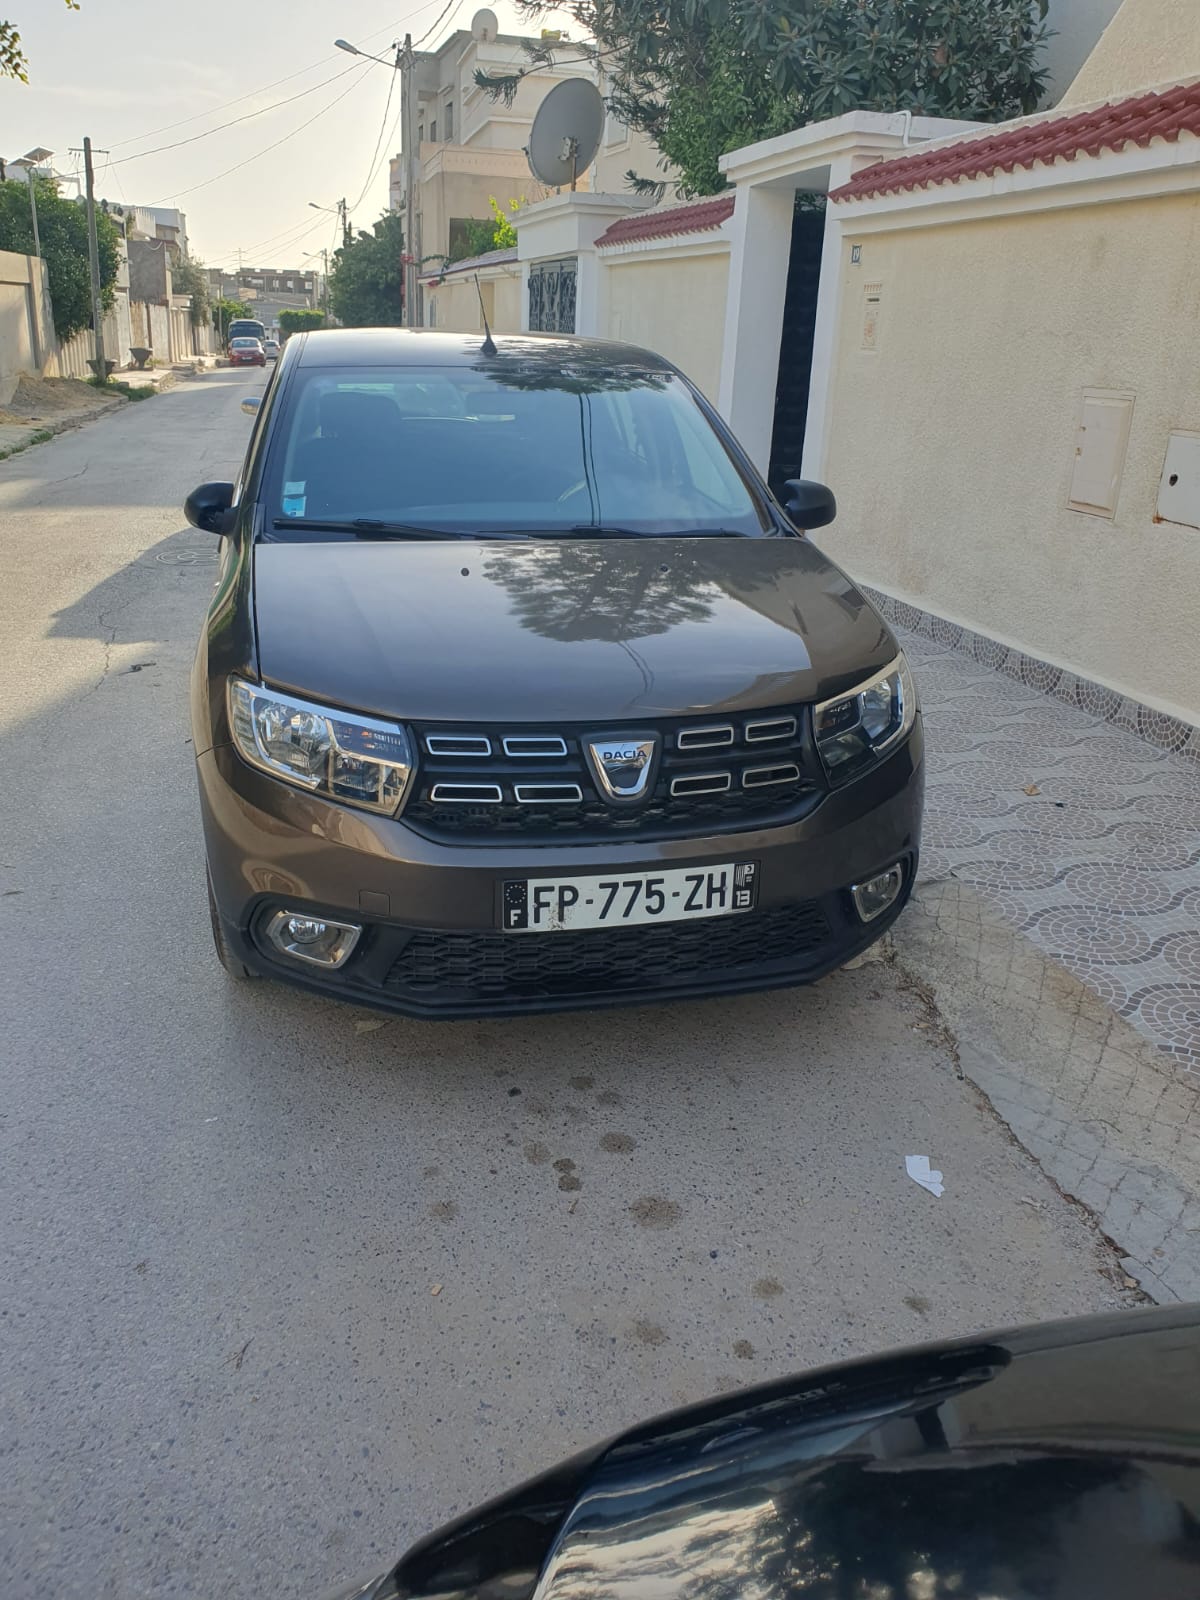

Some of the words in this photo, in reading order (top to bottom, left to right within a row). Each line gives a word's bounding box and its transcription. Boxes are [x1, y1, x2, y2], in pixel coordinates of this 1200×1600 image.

[603, 750, 647, 760] DACIA
[533, 872, 727, 923] FP-775-ZH
[736, 890, 751, 907] 13
[510, 909, 521, 926] F
